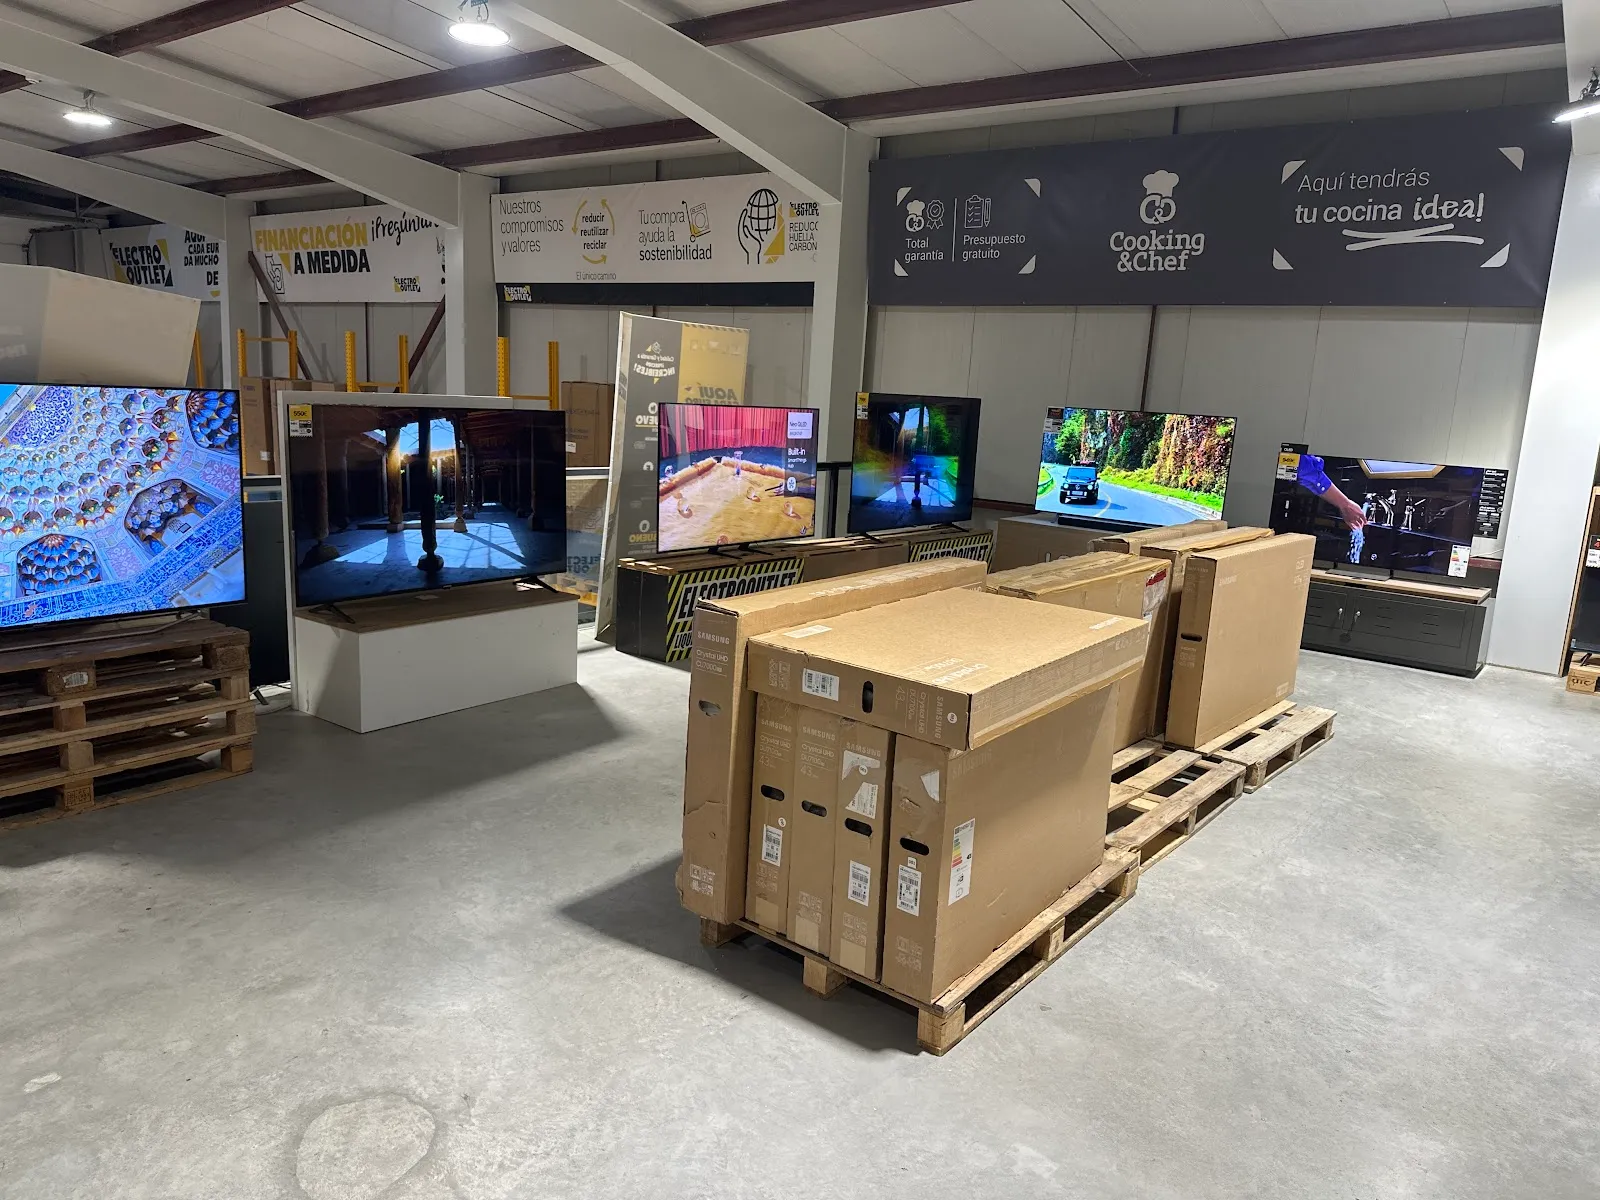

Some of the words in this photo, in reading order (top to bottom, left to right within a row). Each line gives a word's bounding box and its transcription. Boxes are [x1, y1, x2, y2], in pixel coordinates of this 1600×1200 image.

[1297, 172, 1346, 195] Aquí
[1350, 168, 1430, 189] tendrás
[500, 198, 541, 215] Nuestros
[790, 202, 818, 210] ELECTRO
[796, 209, 818, 217] OUTLET
[1295, 204, 1317, 224] tu
[1323, 198, 1402, 222] cocina
[582, 212, 605, 223] reducir
[638, 209, 649, 224] Tu
[650, 211, 685, 227] compra
[500, 216, 564, 236] compromisos
[580, 226, 609, 236] reutilizar
[255, 216, 369, 252] FINANCIACIÓN
[638, 227, 665, 246] ayuda
[668, 226, 676, 242] la
[789, 232, 815, 241] HUELLA
[963, 233, 1026, 249] Presupuesto
[188, 243, 205, 254] CADA
[501, 241, 507, 256] y
[507, 237, 541, 253] valores
[583, 240, 607, 250] reciclar
[905, 237, 929, 249] Total
[1109, 229, 1205, 256] Cooking
[112, 244, 161, 266] ELECTRO
[639, 243, 712, 260] sostenibilidad
[904, 249, 944, 263] garantía
[962, 248, 1000, 262] gratuito
[184, 256, 194, 266] DA
[194, 254, 219, 266] MUCHO
[294, 251, 305, 274] A
[307, 249, 371, 274] MEDIDA
[1117, 251, 1190, 273] &Chef
[126, 265, 166, 285] OUTLET
[206, 270, 219, 285] DE
[394, 277, 417, 285] ELECTRO
[597, 271, 617, 280] camino
[400, 284, 419, 292] OUTLET
[504, 286, 527, 294] ELECTRO
[510, 293, 530, 301] OUTLET
[697, 631, 730, 645] SAMSUNG
[696, 649, 716, 659] Crystal
[716, 653, 728, 662] UHD
[918, 691, 927, 719] Crystal
[934, 695, 944, 739] SAMSUNG
[761, 719, 792, 733] SAMSUNG
[802, 726, 836, 741] SAMSUNG
[822, 749, 835, 757] UHD
[846, 742, 881, 757] SAMSUNG
